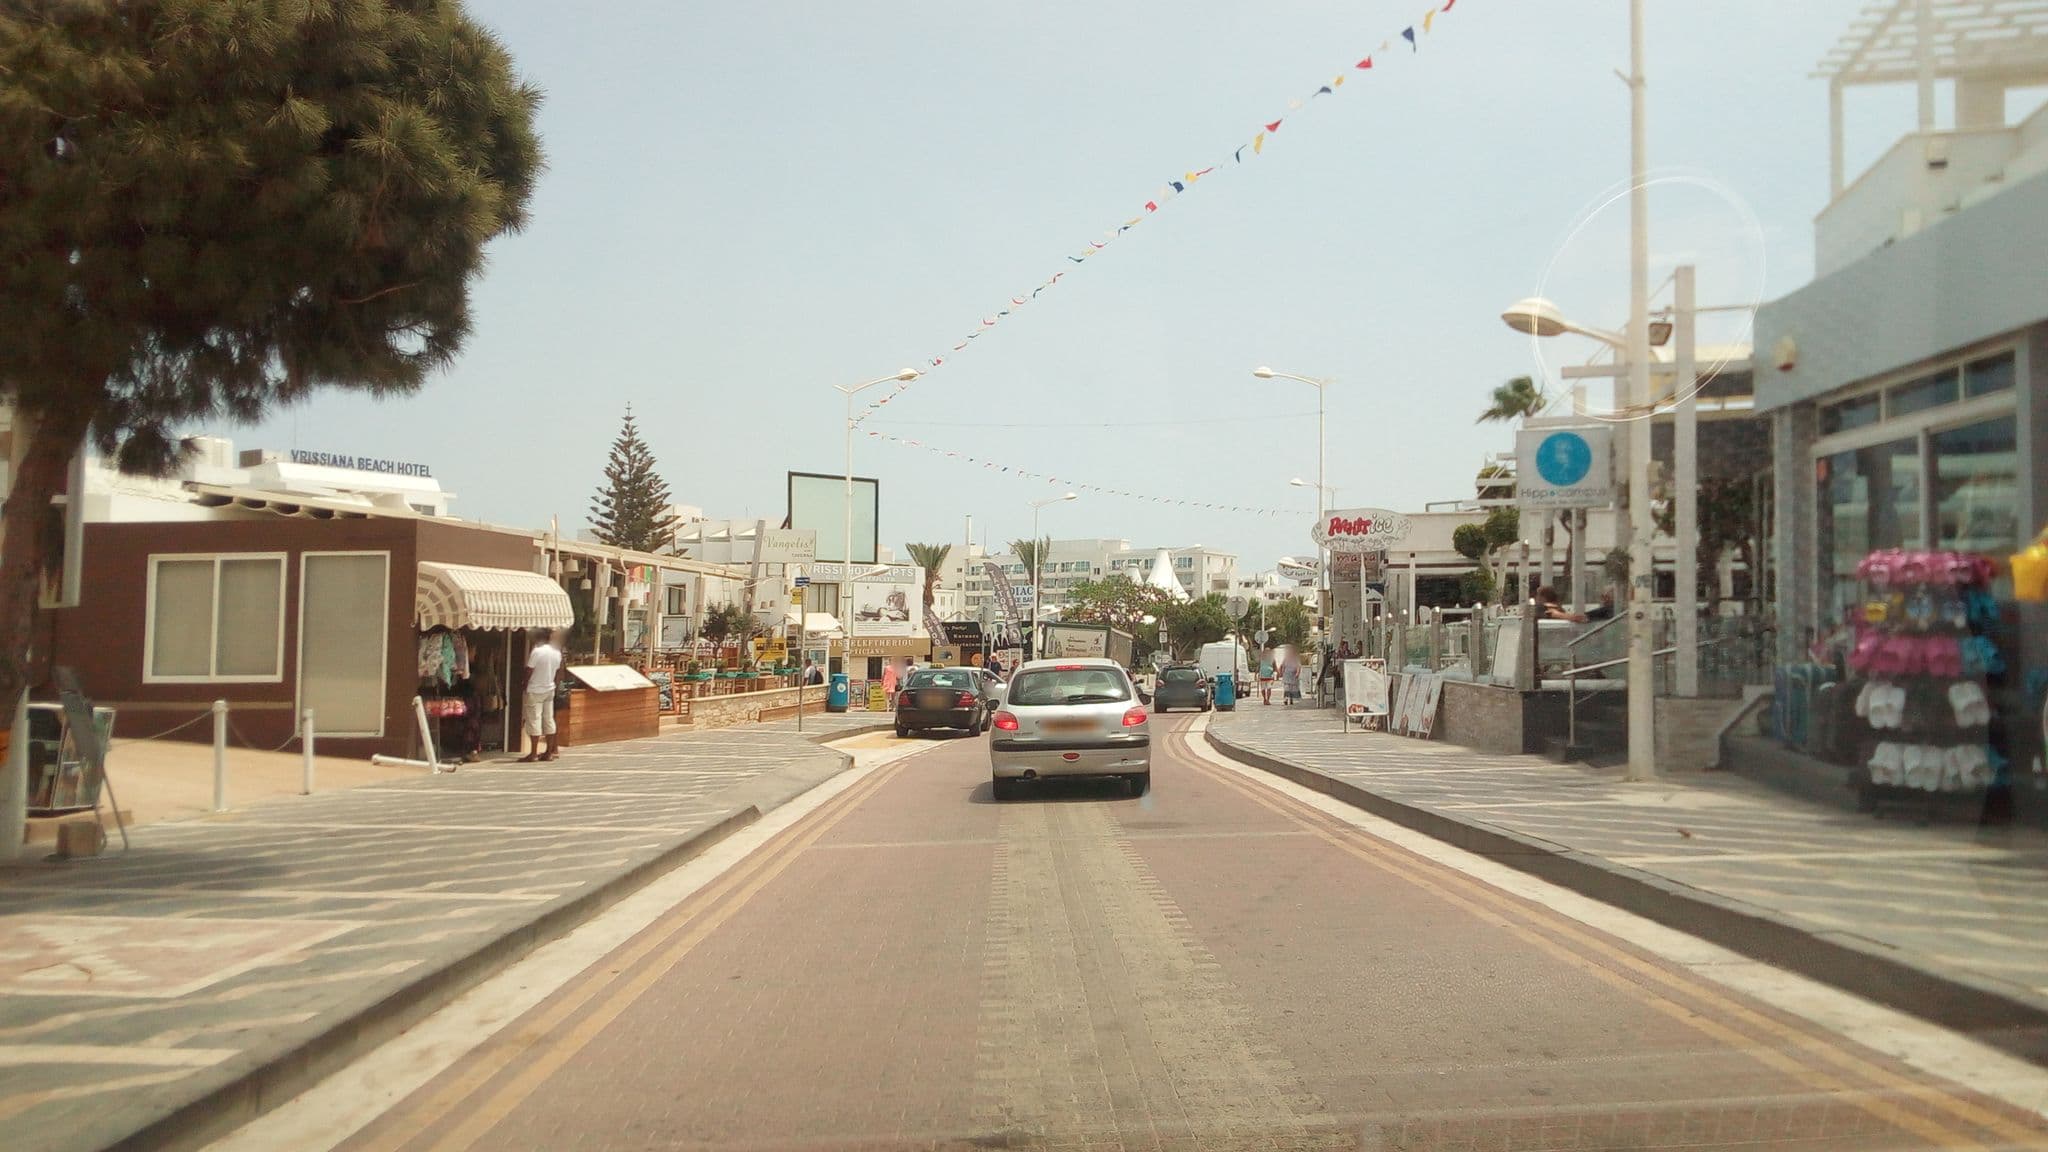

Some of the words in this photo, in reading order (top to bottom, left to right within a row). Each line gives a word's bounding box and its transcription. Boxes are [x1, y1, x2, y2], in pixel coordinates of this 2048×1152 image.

[291, 449, 355, 469] VRISSIANA
[357, 457, 394, 474] BEACH
[397, 462, 432, 478] HOTEL
